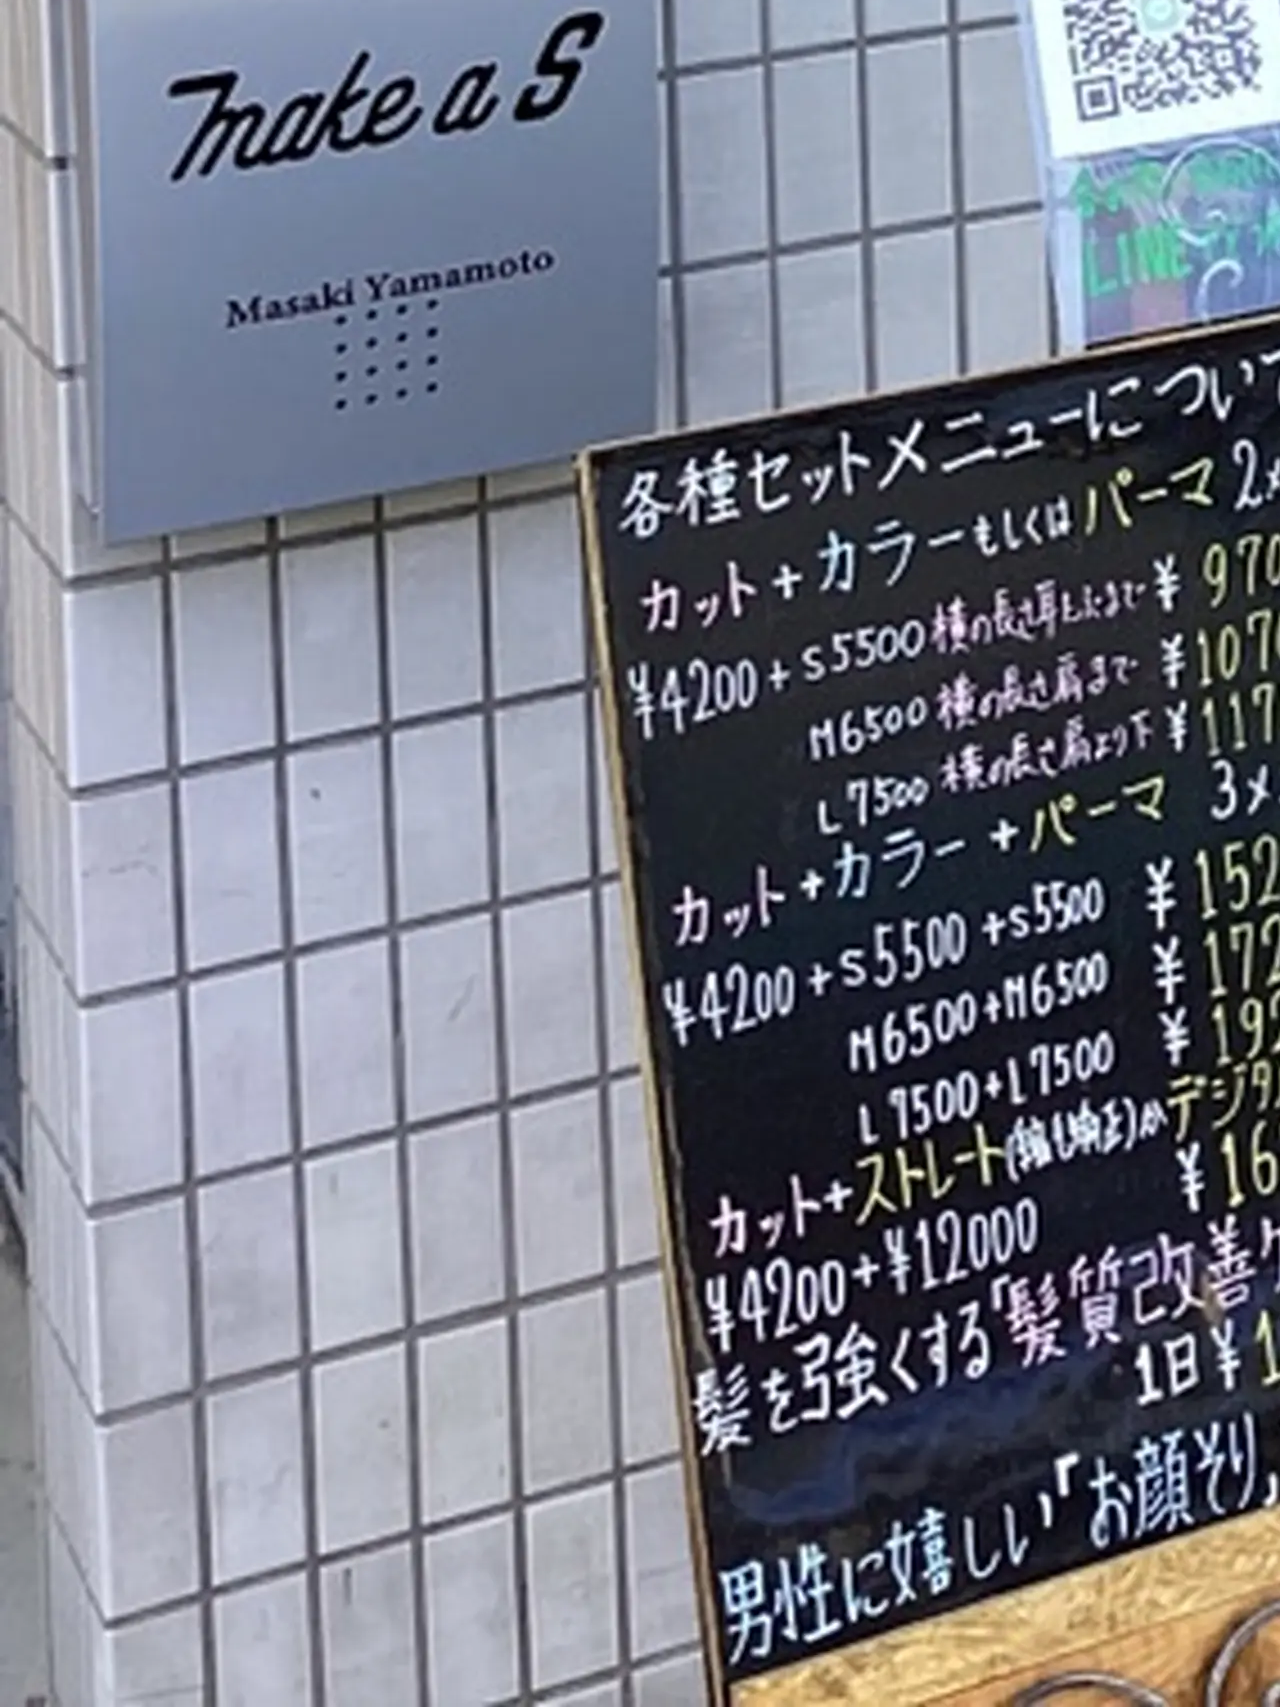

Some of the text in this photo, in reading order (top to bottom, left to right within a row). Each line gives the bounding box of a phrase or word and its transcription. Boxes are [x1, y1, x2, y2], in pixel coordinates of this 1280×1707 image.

[167, 12, 605, 183] make a S
[224, 247, 555, 330] Masaki Yamamoto
